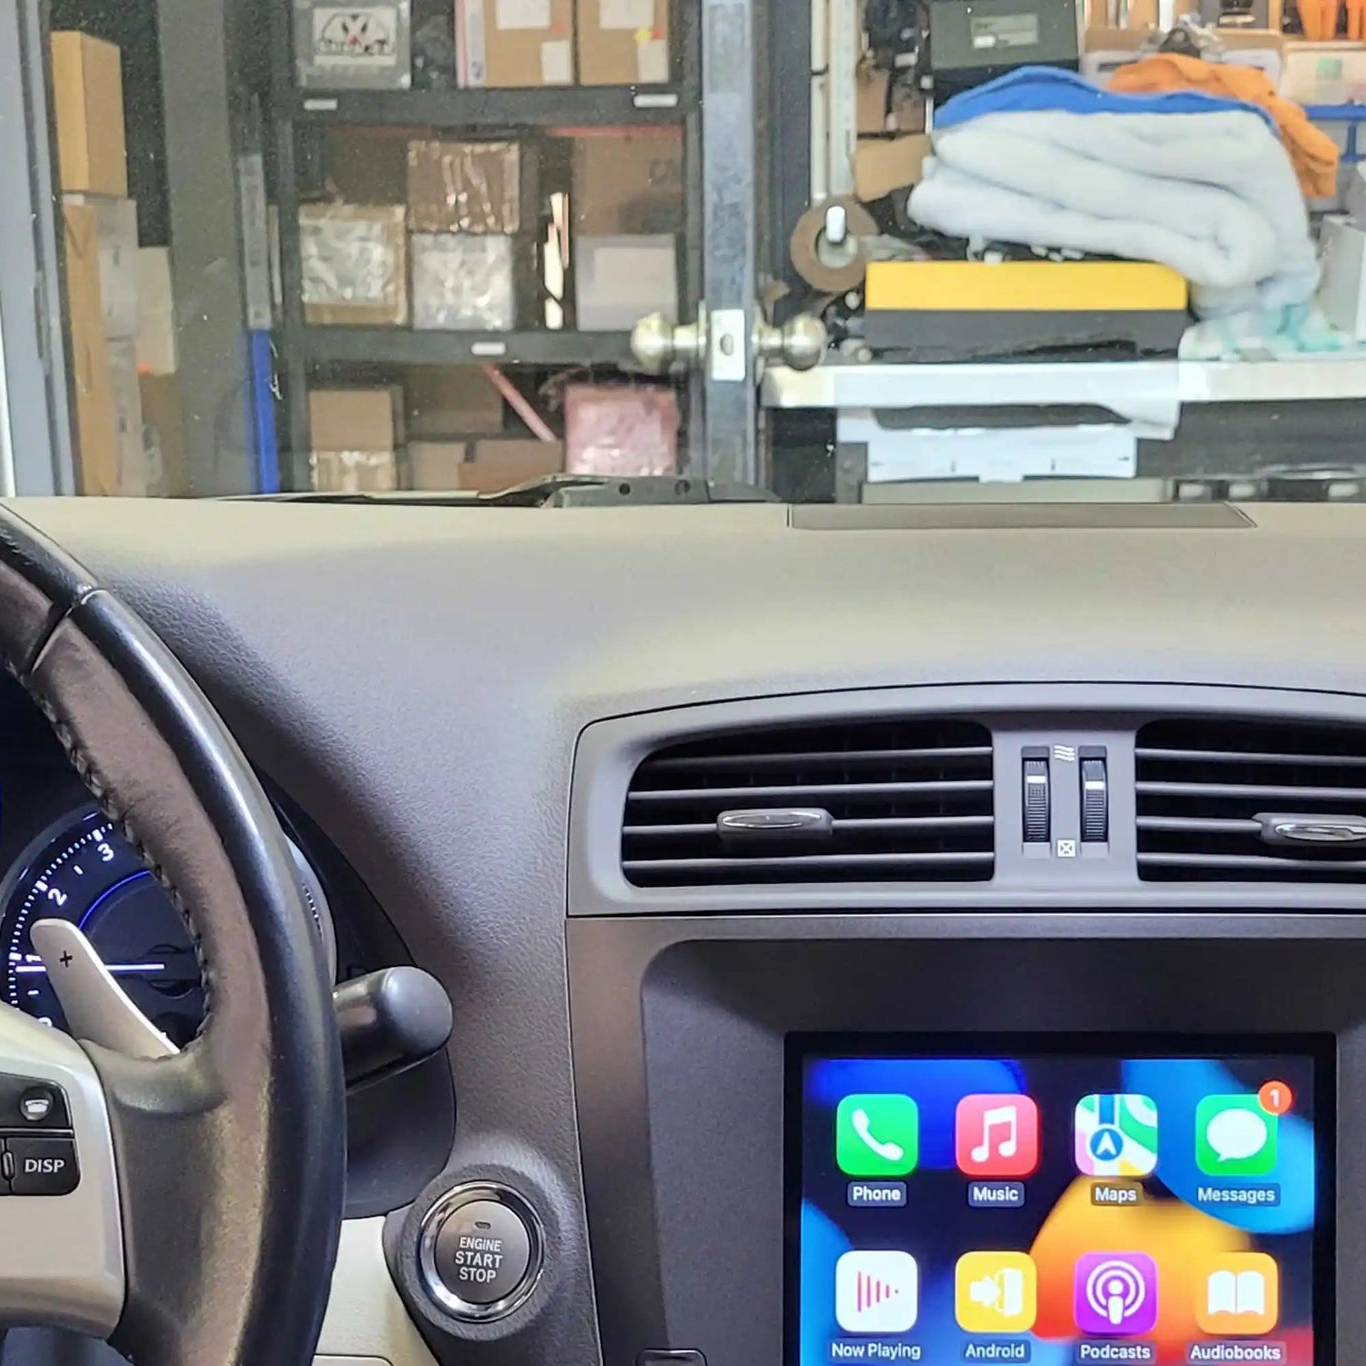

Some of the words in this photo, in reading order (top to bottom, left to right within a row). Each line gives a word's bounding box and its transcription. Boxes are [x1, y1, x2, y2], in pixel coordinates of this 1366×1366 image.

[97, 843, 115, 862] 3
[47, 887, 67, 906] 2
[1268, 1089, 1280, 1107] 1
[24, 1158, 65, 1173] DISP
[852, 1186, 902, 1202] Phone
[973, 1186, 1019, 1202] Music
[1095, 1187, 1137, 1205] Maps
[1197, 1187, 1275, 1206] Messages
[459, 1236, 503, 1252] ENGINE
[455, 1251, 503, 1268] START
[459, 1266, 497, 1283] STOP
[831, 1343, 865, 1358] Now
[869, 1343, 921, 1362] Playing
[965, 1343, 1025, 1359] Android
[1080, 1344, 1151, 1360] Podcasts
[1190, 1344, 1281, 1361] Audiobooks
